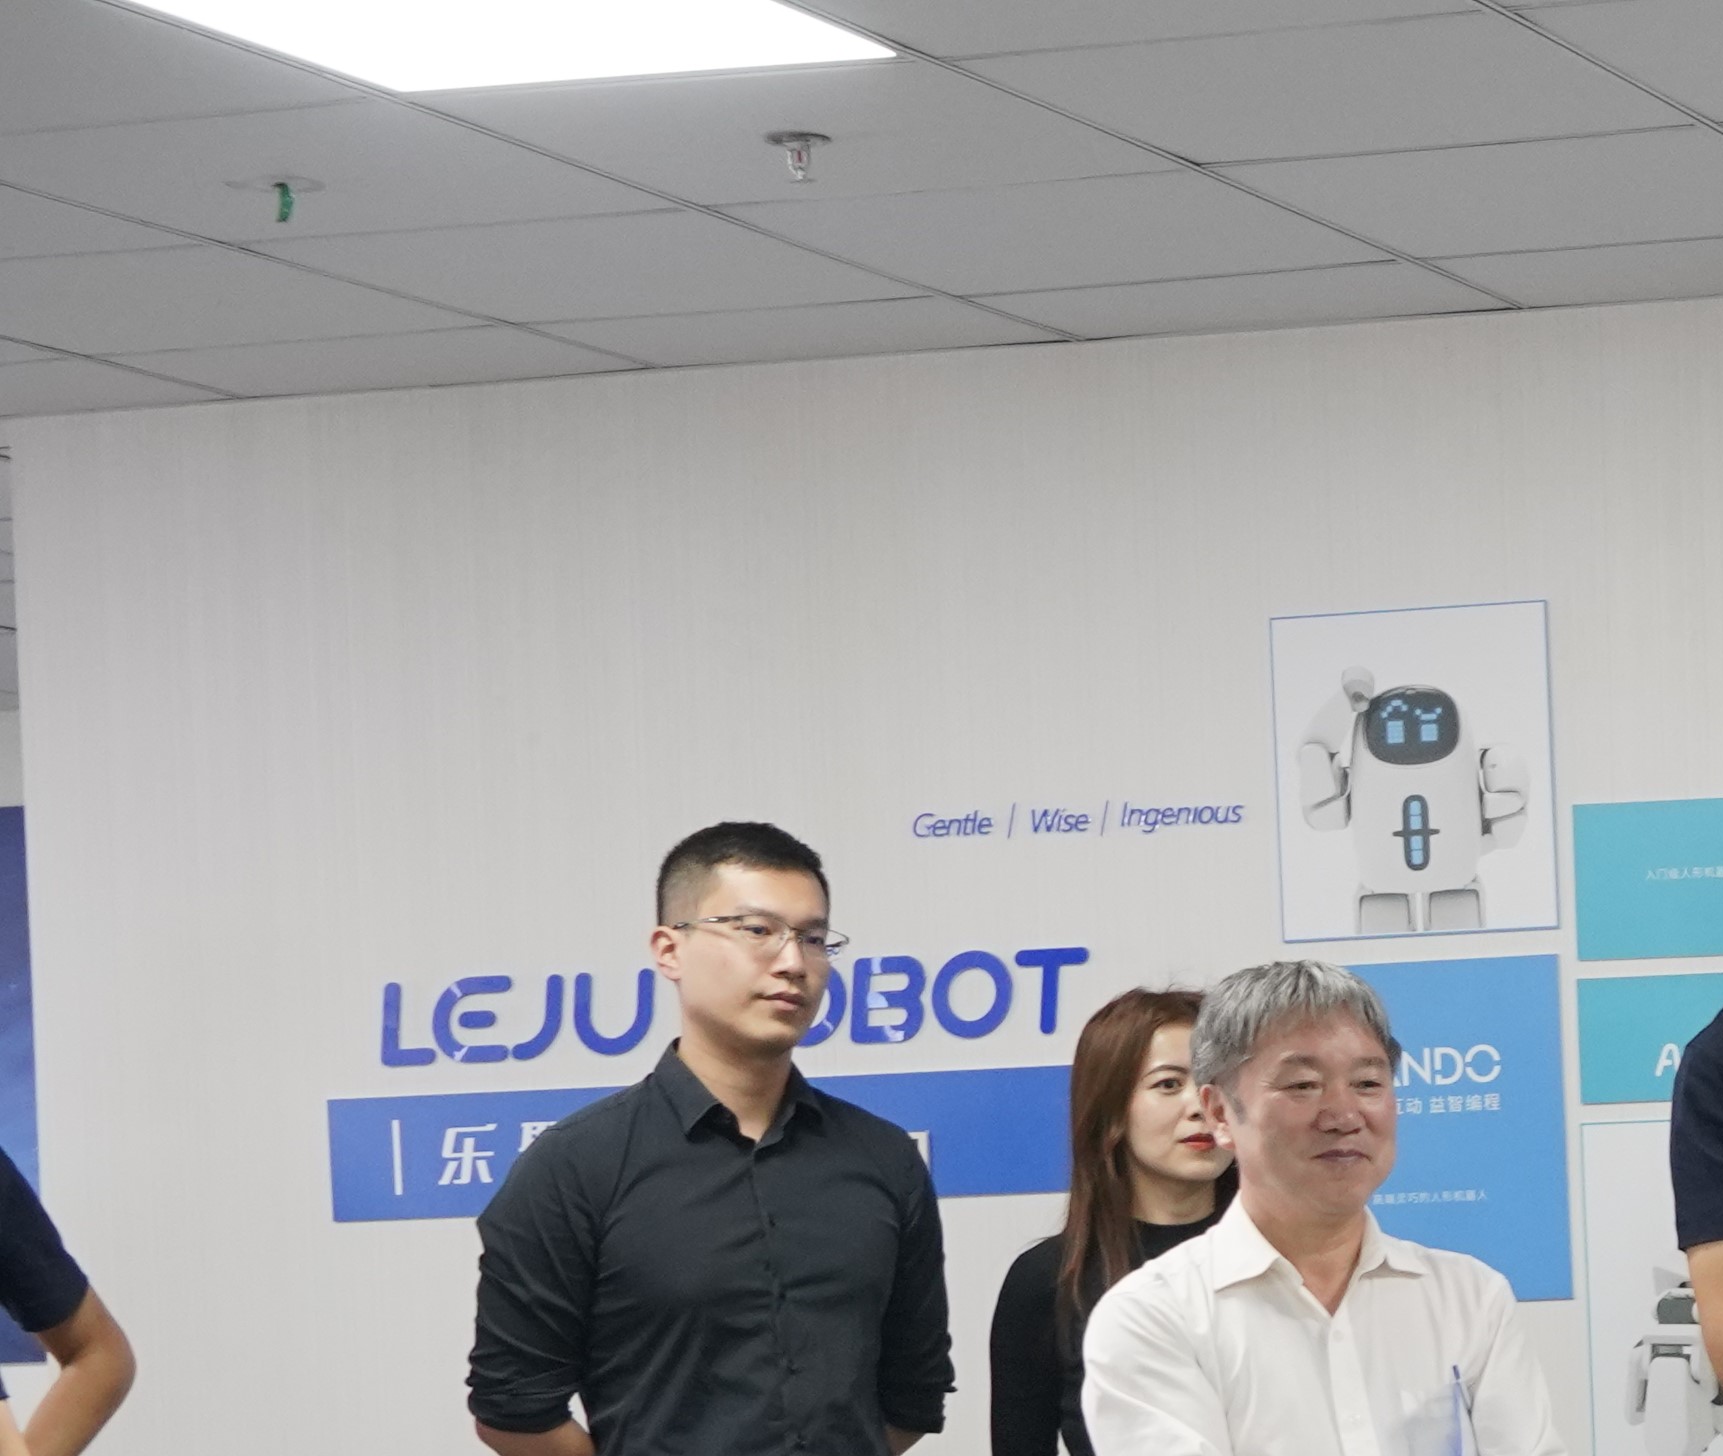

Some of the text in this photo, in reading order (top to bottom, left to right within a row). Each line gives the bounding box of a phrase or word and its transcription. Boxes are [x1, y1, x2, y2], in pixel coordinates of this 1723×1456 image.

[912, 801, 1245, 838] Gentle Wise Ingenious
[381, 947, 1090, 1067] LEJU BOT
[1429, 1093, 1500, 1114] 益智编程
